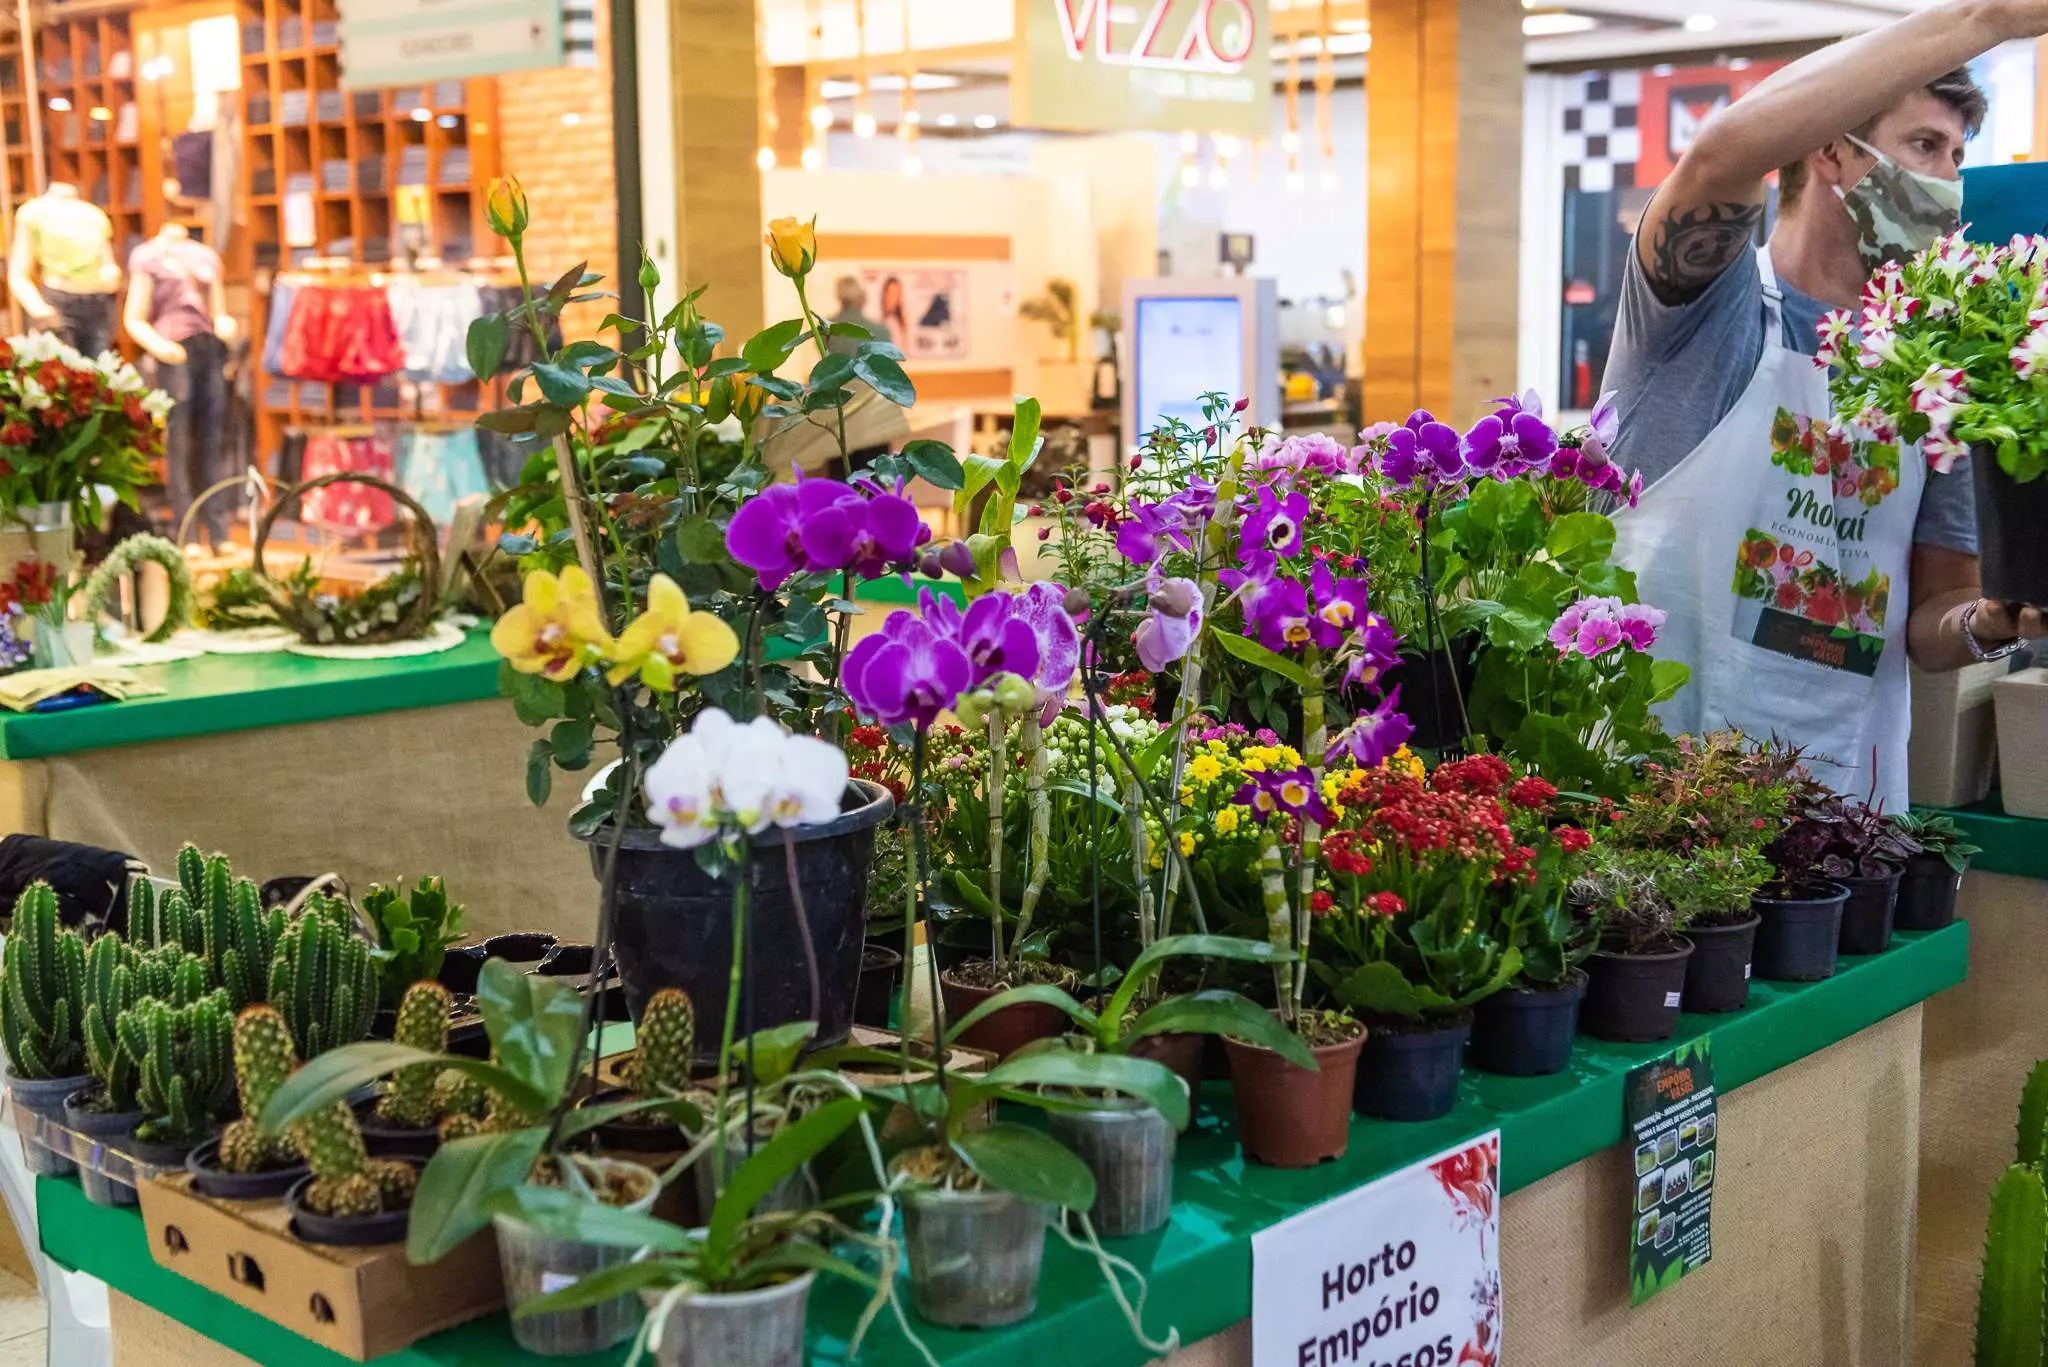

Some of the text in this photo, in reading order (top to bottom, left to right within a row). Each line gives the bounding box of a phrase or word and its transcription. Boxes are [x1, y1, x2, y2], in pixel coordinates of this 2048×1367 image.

[1771, 521, 1837, 549] ECONOMIA
[1786, 488, 1869, 542] Moaí
[1322, 1240, 1416, 1310] Horto
[1298, 1281, 1440, 1367] Empório
